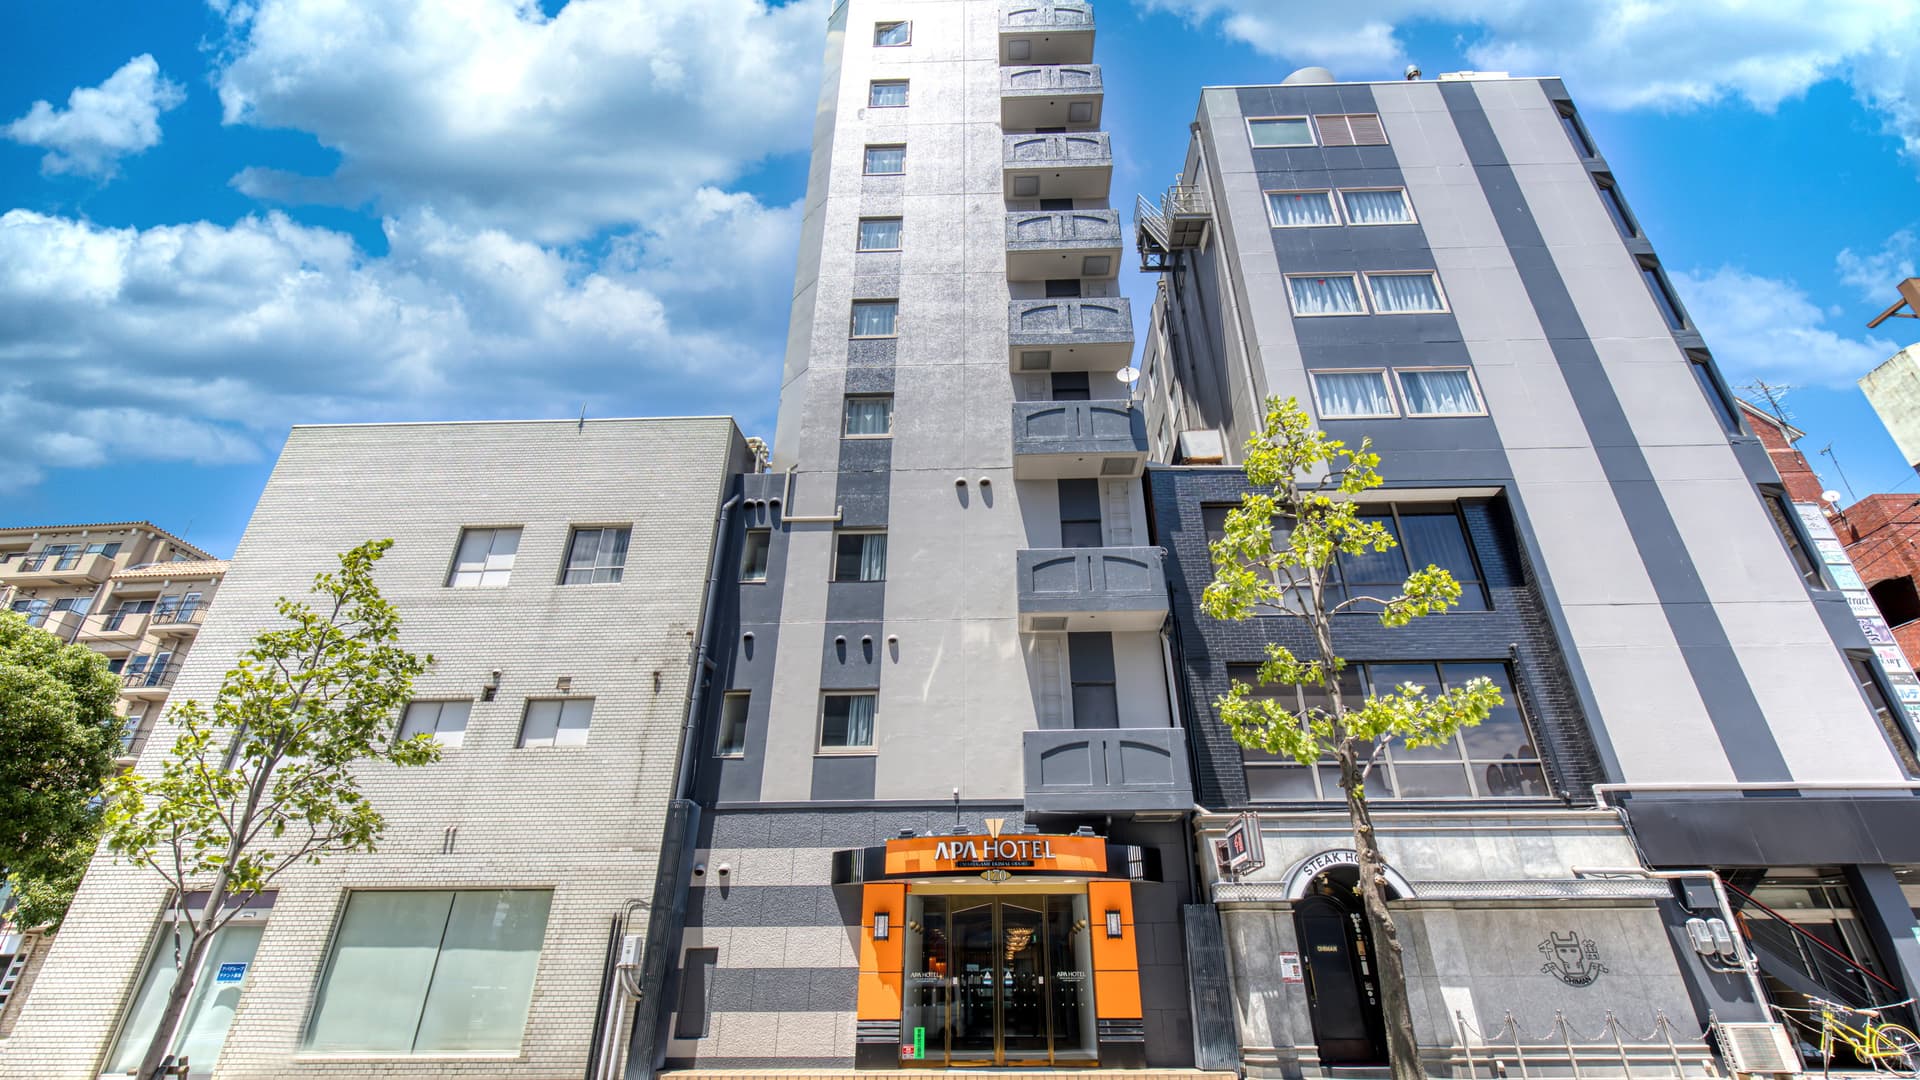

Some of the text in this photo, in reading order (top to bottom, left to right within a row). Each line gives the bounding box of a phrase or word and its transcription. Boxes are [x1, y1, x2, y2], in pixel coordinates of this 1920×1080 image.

[934, 840, 1056, 860] APA HOTEL
[1303, 852, 1341, 876] STEAK
